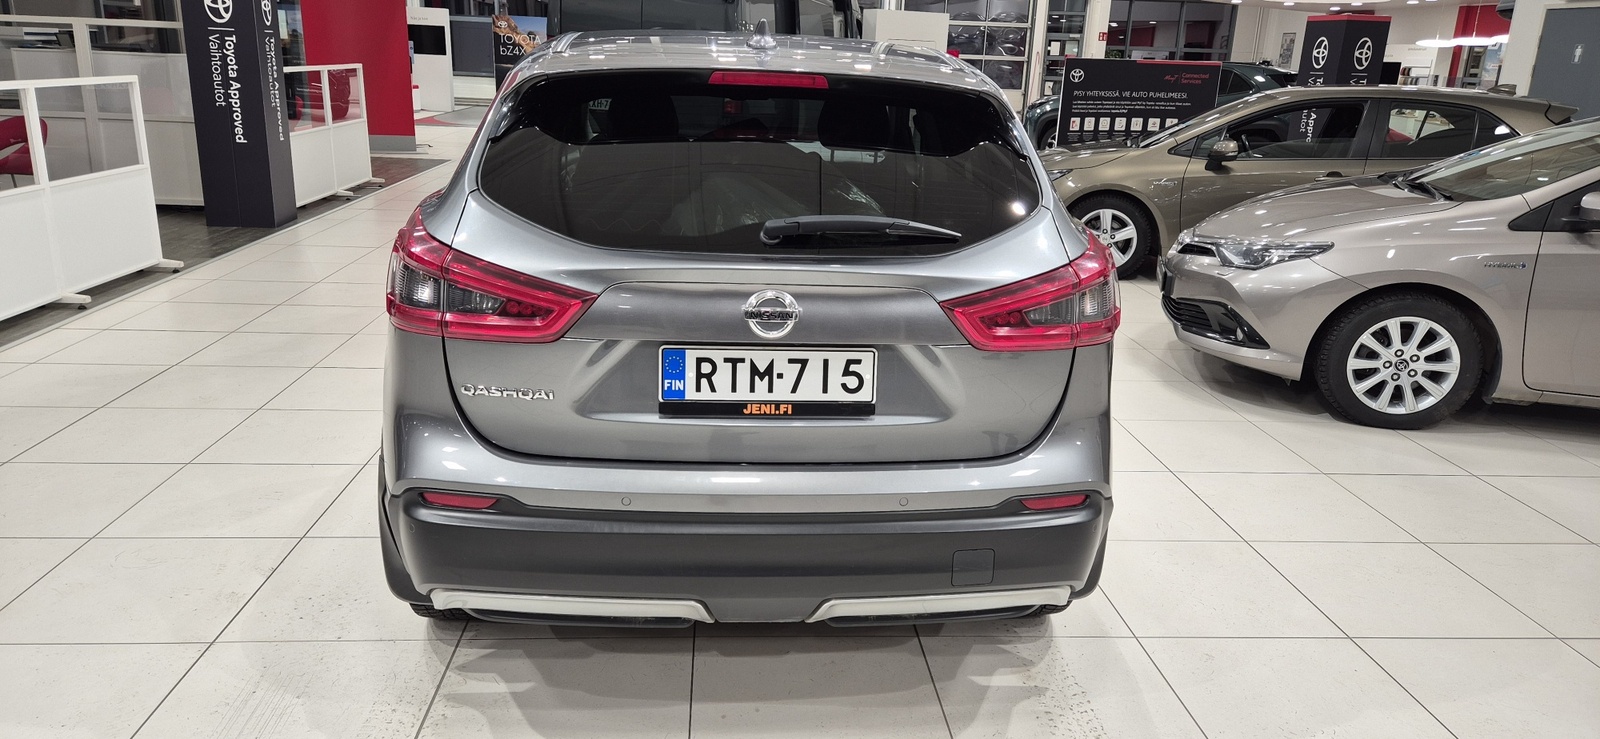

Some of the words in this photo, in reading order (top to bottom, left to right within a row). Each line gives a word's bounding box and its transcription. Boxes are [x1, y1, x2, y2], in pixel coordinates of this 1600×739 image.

[500, 34, 541, 45] TOYOTA
[500, 45, 526, 56] bZ4X
[223, 34, 238, 78] Toyota
[208, 34, 226, 107] Vaihtoautot
[264, 36, 276, 108] Vaihtoautot
[269, 37, 277, 78] Toyota
[274, 81, 284, 141] Approved
[1122, 90, 1131, 98] VIE
[228, 80, 247, 143] Approved
[749, 310, 794, 320] NISSAN
[664, 379, 684, 391] FIN
[695, 356, 865, 395] RTM-715
[461, 383, 555, 401] QASHQAI
[743, 403, 792, 415] JENI.FI
